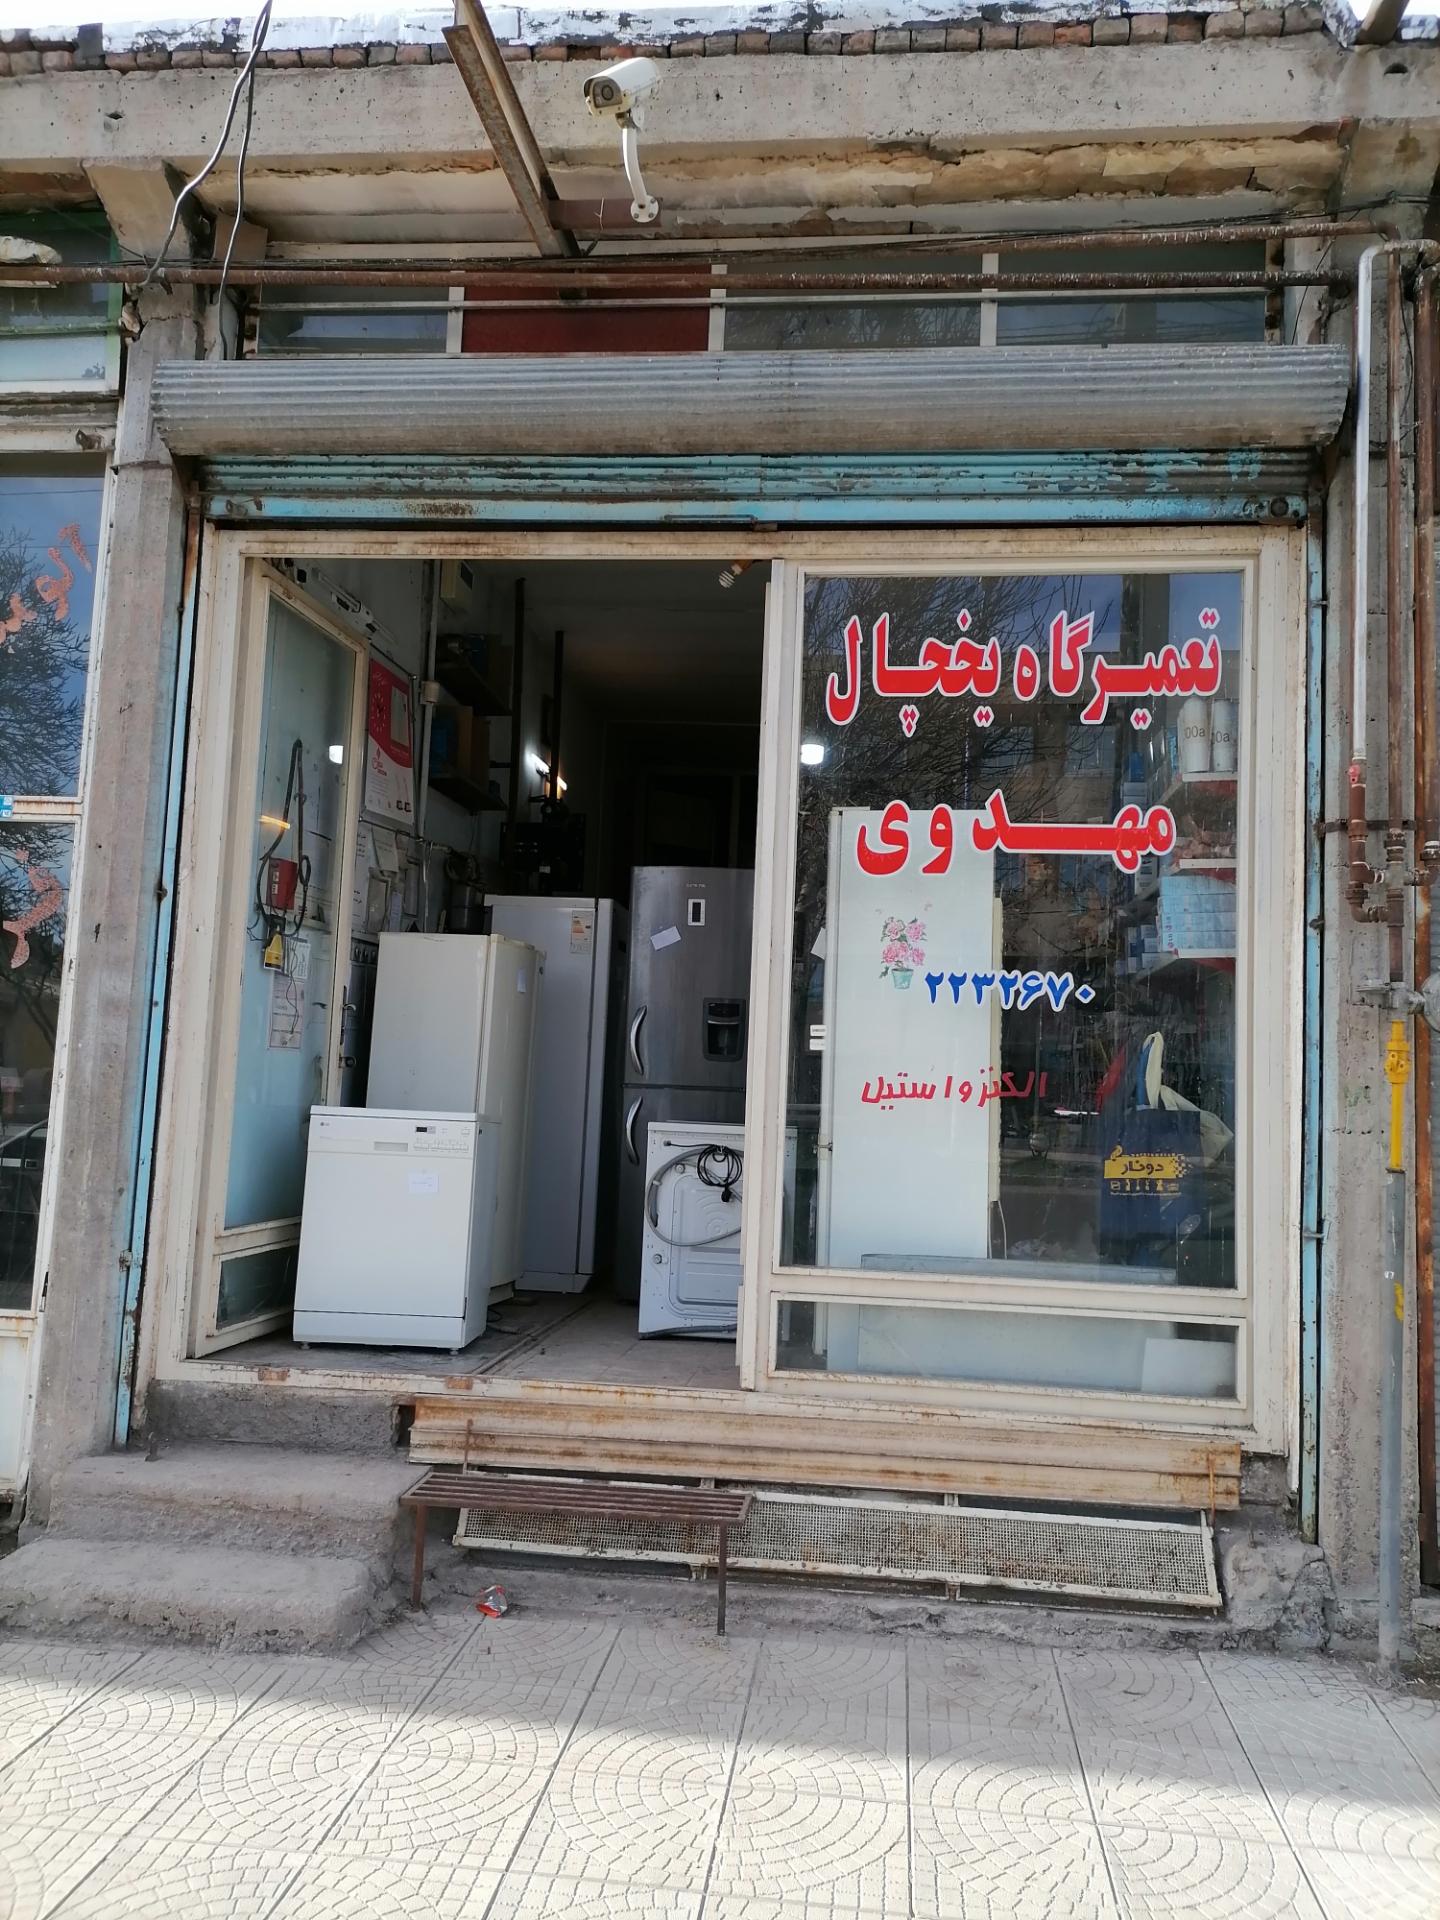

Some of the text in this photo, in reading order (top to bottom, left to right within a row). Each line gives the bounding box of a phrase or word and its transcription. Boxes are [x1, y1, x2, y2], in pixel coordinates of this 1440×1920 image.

[826, 608, 1222, 737] تعمیرگاه یخچال
[857, 789, 1177, 876] مهدوی
[924, 970, 1096, 1012] ۲۲۳۲۶۷۰
